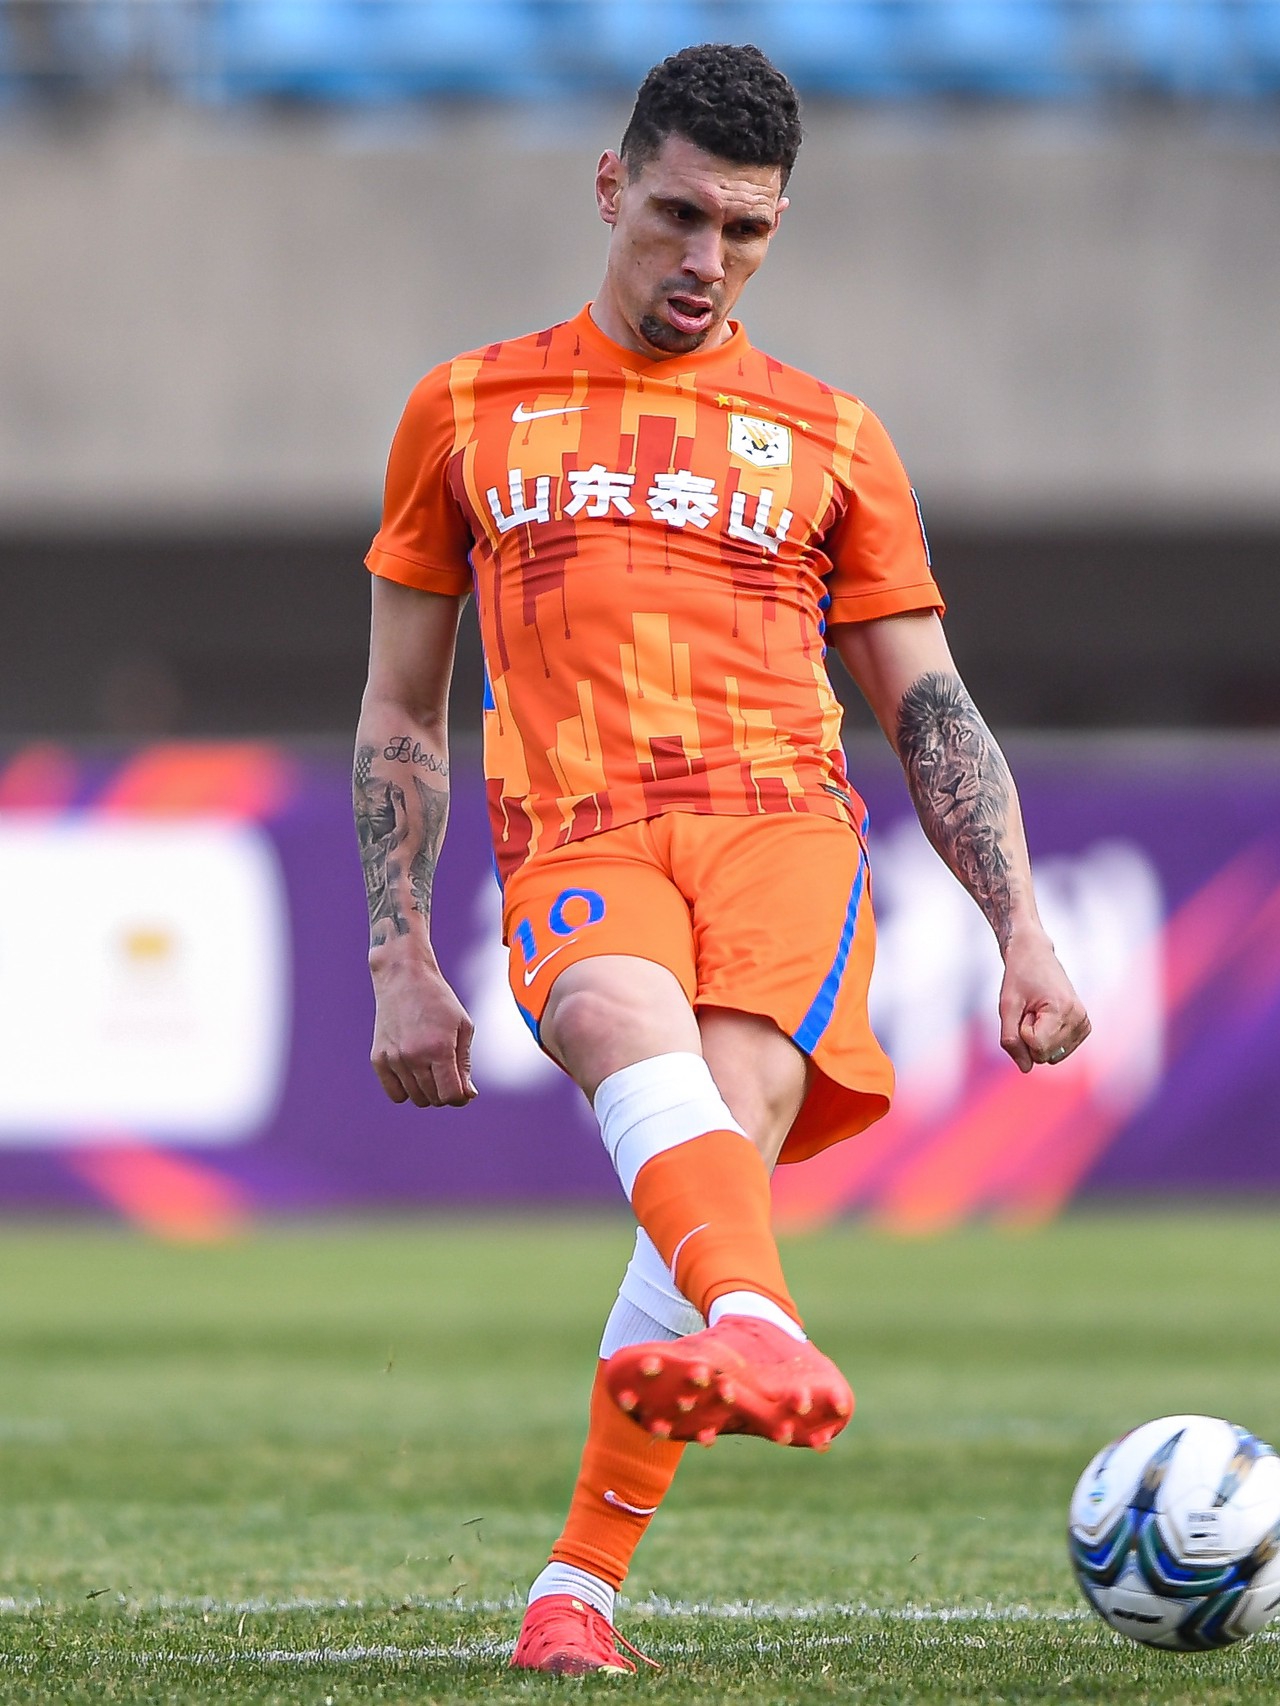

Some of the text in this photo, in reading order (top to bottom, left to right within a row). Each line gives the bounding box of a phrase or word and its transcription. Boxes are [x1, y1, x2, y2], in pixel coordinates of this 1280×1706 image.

[486, 464, 793, 555] 山东泰山
[512, 887, 606, 965] 10
